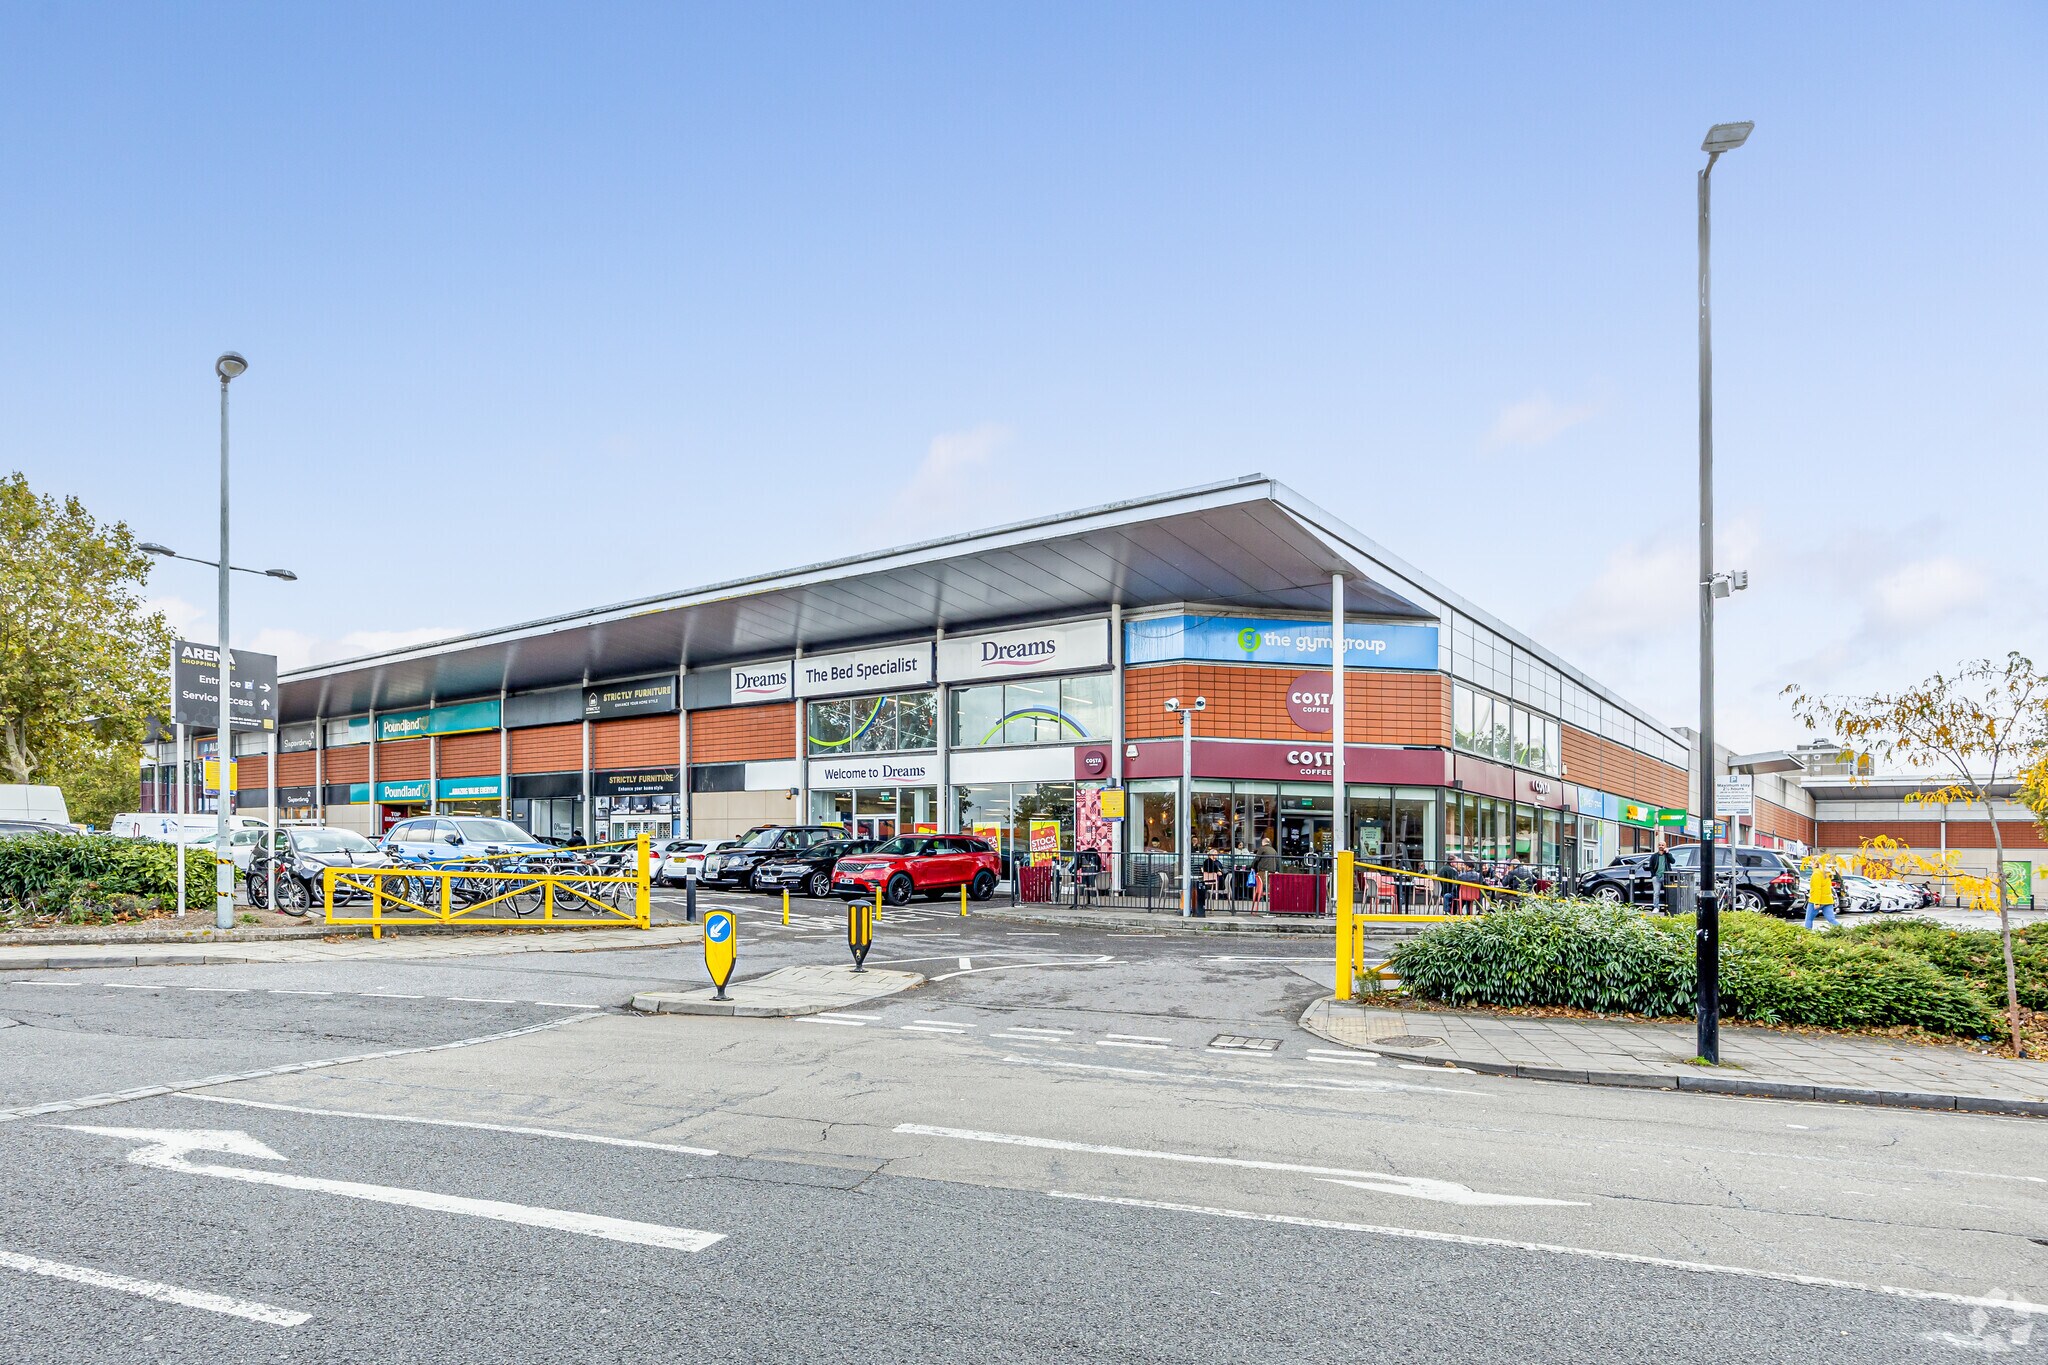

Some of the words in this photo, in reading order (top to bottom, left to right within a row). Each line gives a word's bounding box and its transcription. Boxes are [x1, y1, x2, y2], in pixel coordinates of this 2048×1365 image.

[1264, 632, 1291, 646] the
[1296, 636, 1332, 652] gym
[981, 638, 1056, 662] Dreams
[181, 658, 216, 668] SHOPPING
[806, 668, 828, 684] The
[831, 665, 853, 681] Bed
[856, 657, 918, 680] Specialist
[199, 675, 241, 688] Entrce
[735, 671, 787, 690] Dreams
[182, 690, 218, 703] Service
[229, 697, 253, 707] ccess
[603, 690, 633, 702] STRICTLY
[634, 686, 671, 698] FURNITURE
[1302, 706, 1330, 714] COFFEE
[384, 717, 421, 733] Poundland
[209, 742, 220, 752] ALD
[284, 739, 312, 748] Superdrug
[1287, 751, 1345, 767] COST
[609, 776, 637, 784] STRICTLY
[638, 774, 674, 783] FURNITURE
[824, 769, 867, 780] Welcome
[869, 768, 879, 779] to
[882, 764, 926, 778] Dreams
[1300, 768, 1332, 776] COFFEE
[384, 785, 421, 798] Poundland
[1031, 835, 1056, 848] STOCK
